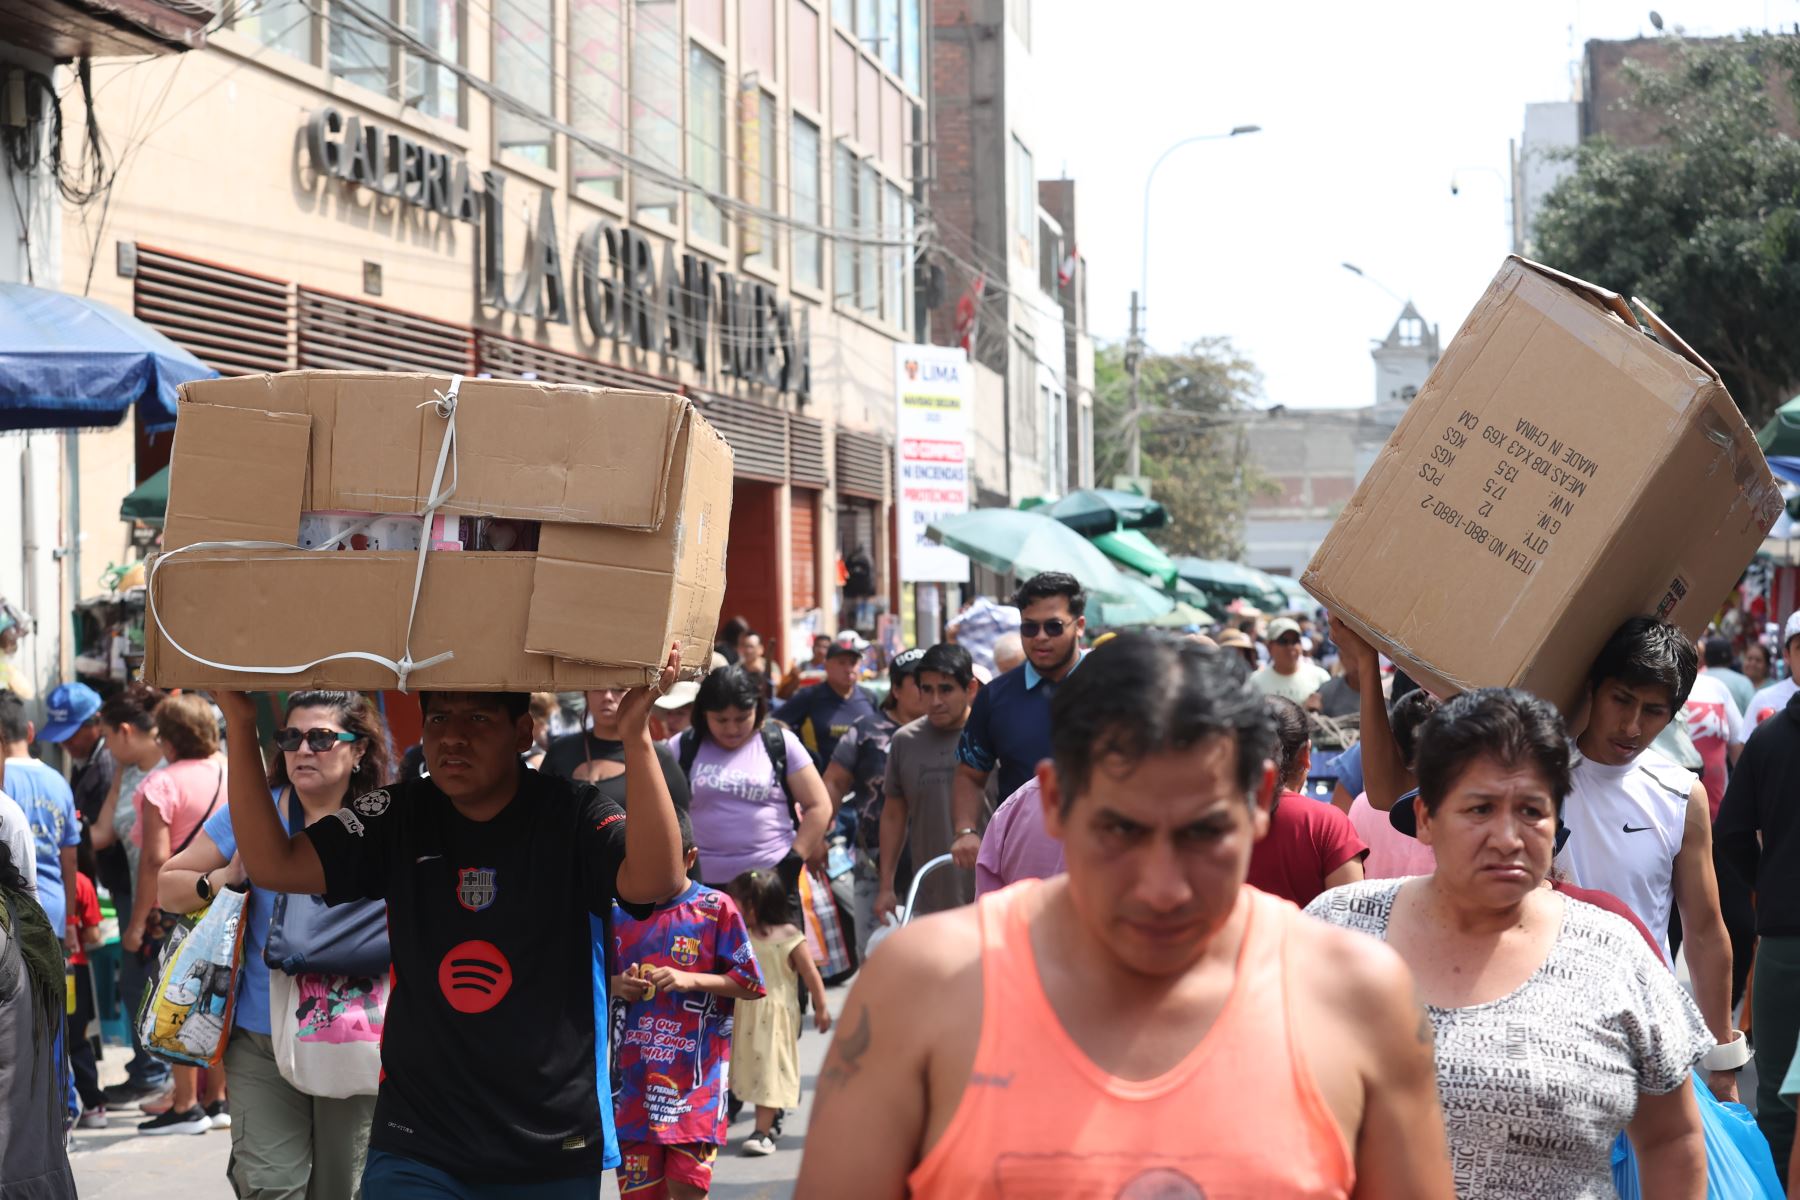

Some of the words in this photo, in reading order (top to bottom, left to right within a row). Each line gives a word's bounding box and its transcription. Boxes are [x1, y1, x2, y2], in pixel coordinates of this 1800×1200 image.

[307, 107, 481, 226] GALERIA
[481, 170, 569, 325] LA
[922, 365, 960, 383] LIMA
[1458, 410, 1479, 430] CM
[1442, 426, 1467, 449] KGS
[1515, 417, 1549, 447] CHINA
[1430, 444, 1456, 468] KGS
[1548, 439, 1564, 457] IN
[1495, 460, 1520, 483] 13.5
[1561, 447, 1599, 478] MADE
[1418, 463, 1445, 487] PCS
[1483, 478, 1507, 501] 17.5
[1478, 500, 1494, 518] 12
[1505, 548, 1537, 576] ITEM
[655, 1018, 682, 1035] QUE
[653, 1033, 697, 1053] SOMOS
[1508, 1132, 1574, 1153] MUSICAL
